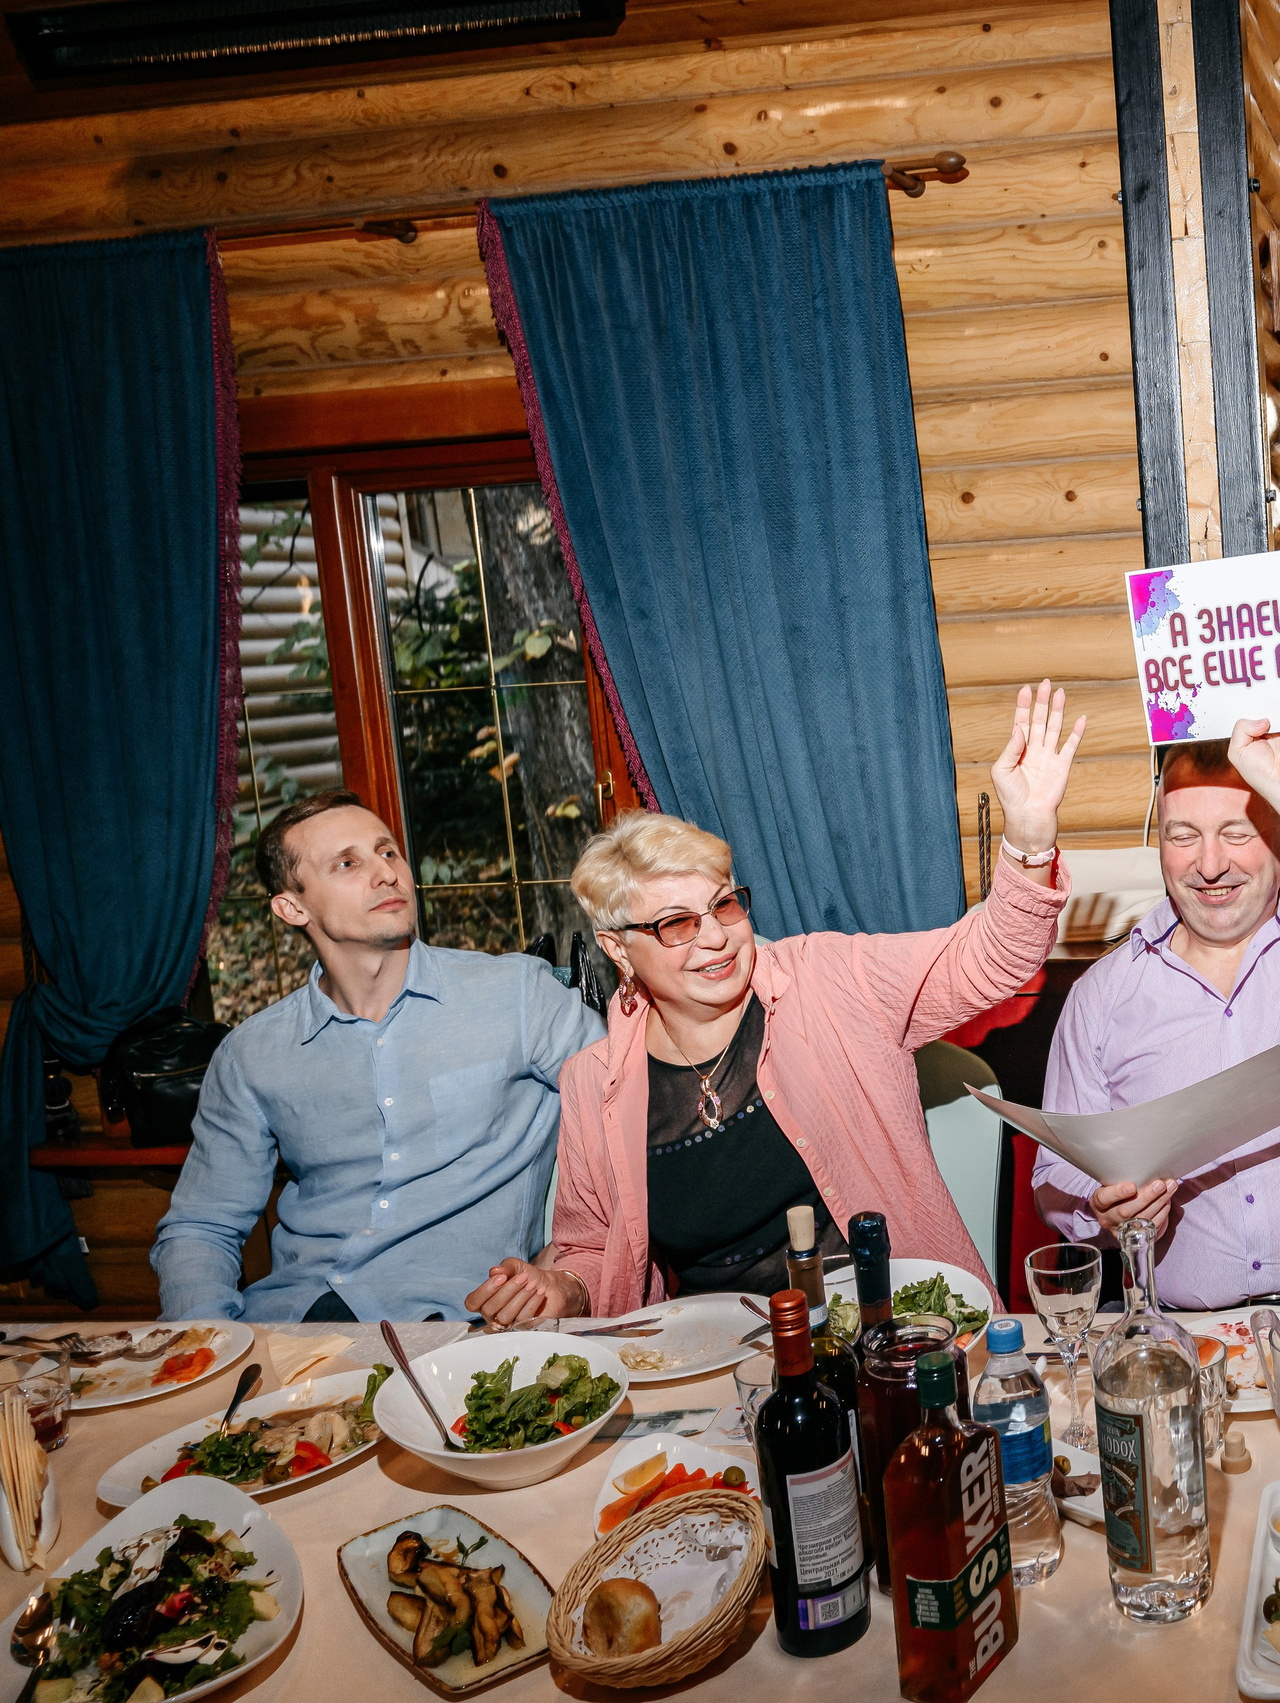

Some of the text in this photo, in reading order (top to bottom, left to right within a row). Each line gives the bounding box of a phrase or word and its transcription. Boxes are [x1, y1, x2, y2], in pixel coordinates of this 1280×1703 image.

[1169, 612, 1189, 648] А
[1145, 654, 1195, 693] ВСЕ
[1203, 645, 1266, 687] ЕЩЕ
[988, 1436, 998, 1485] WHISKEY
[1100, 1432, 1137, 1462] HODOX
[824, 1568, 838, 1578] 2021
[960, 1437, 1004, 1672] BUSKER
